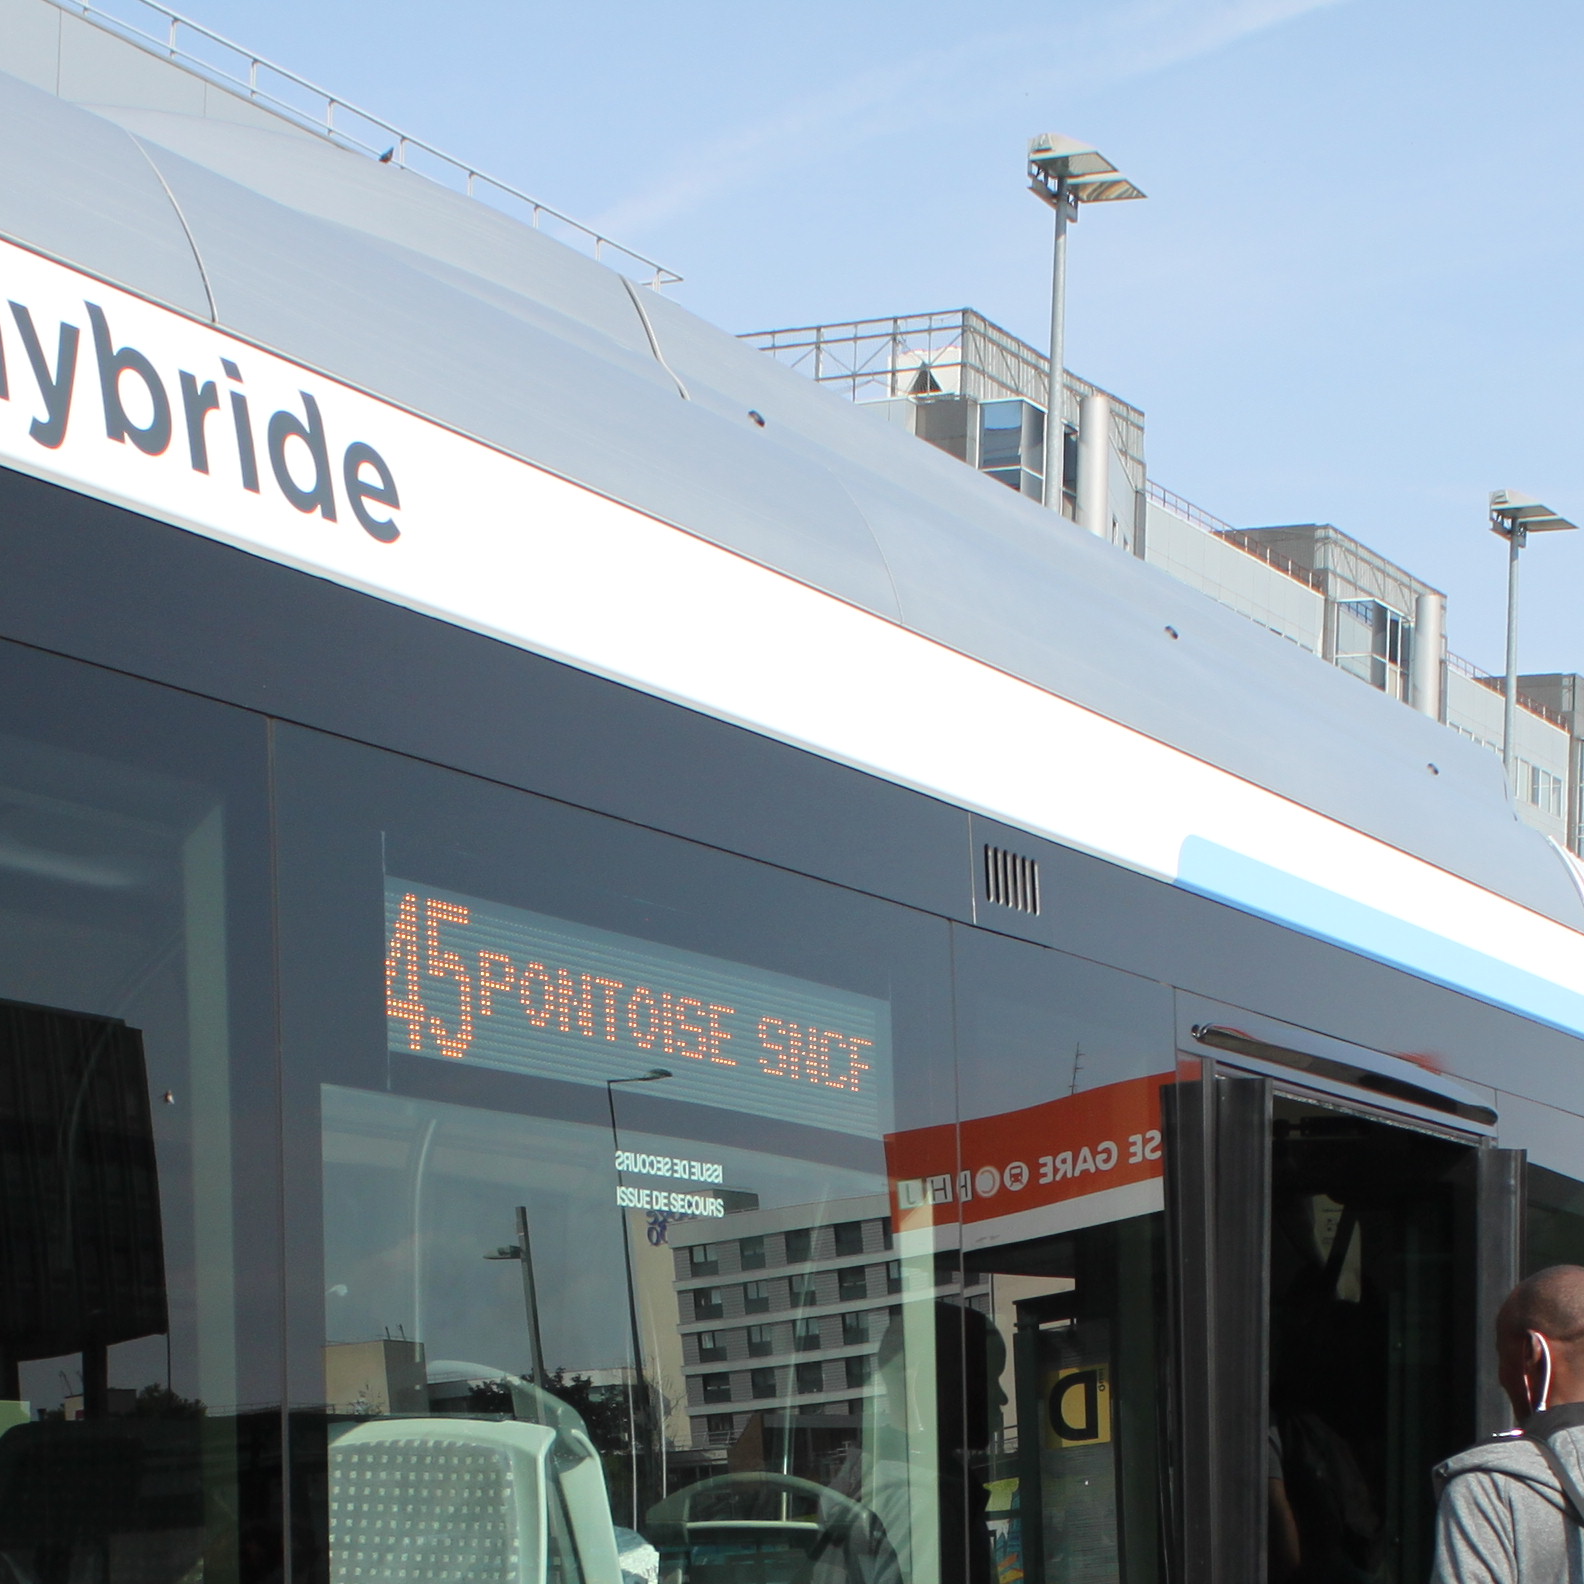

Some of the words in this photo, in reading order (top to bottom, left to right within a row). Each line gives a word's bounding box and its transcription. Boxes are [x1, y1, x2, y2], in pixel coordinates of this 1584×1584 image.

[385, 892, 473, 1059] 45
[478, 949, 738, 1066] PONTOISE
[758, 1016, 874, 1092] SNCF
[616, 1186, 651, 1210] ISSUE
[652, 1190, 670, 1212] DE
[670, 1192, 725, 1219] SECOURS
